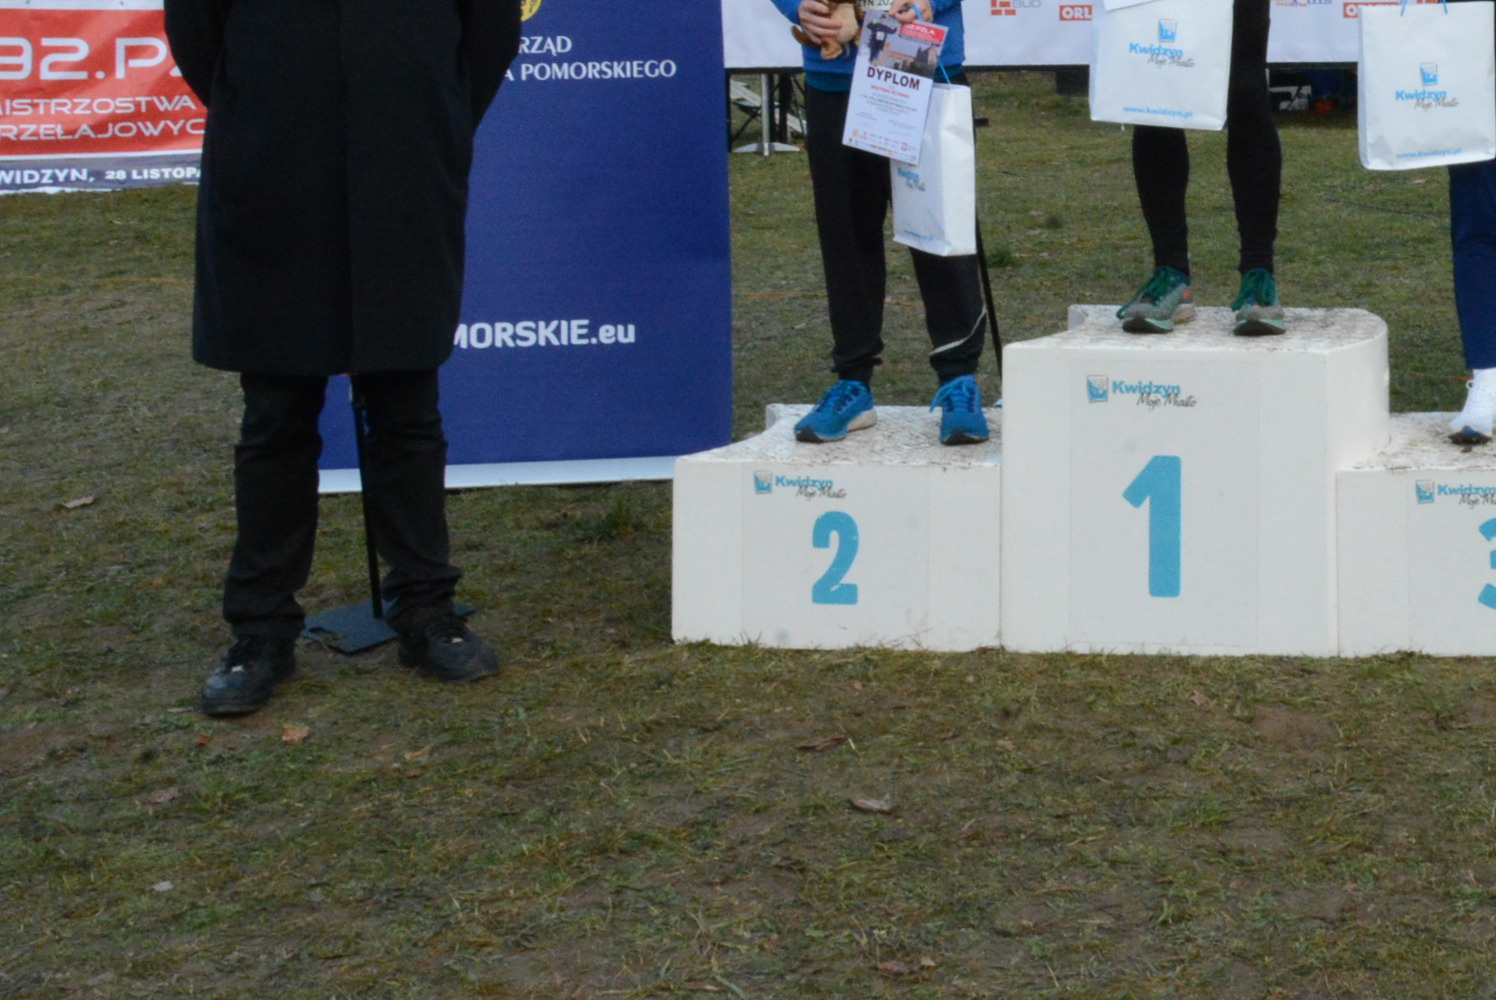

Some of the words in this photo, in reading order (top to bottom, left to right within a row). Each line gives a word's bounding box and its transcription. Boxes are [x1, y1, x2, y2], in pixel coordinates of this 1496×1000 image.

[1062, 7, 1092, 20] ORL
[519, 36, 573, 56] RZĄD
[1129, 42, 1184, 60] Kwidzyn
[0, 37, 182, 80] 92.P
[521, 59, 677, 81] POMORSKIEGO
[867, 66, 921, 91] DYPLOM
[0, 95, 197, 116] ISTRZOSTWA
[1395, 89, 1447, 102] Kwidzyn
[0, 118, 205, 141] RZEŁAJOWYC
[0, 167, 95, 184] WIDZYN,
[105, 169, 127, 180] 28
[132, 166, 201, 180] LISTOP
[454, 319, 636, 349] MORSKIE.eu
[1112, 380, 1181, 399] Kwidzyn
[775, 475, 834, 491] Kwidzyn
[1437, 484, 1496, 498] Kwidzyn
[1122, 455, 1182, 598] 1
[812, 510, 860, 605] 2
